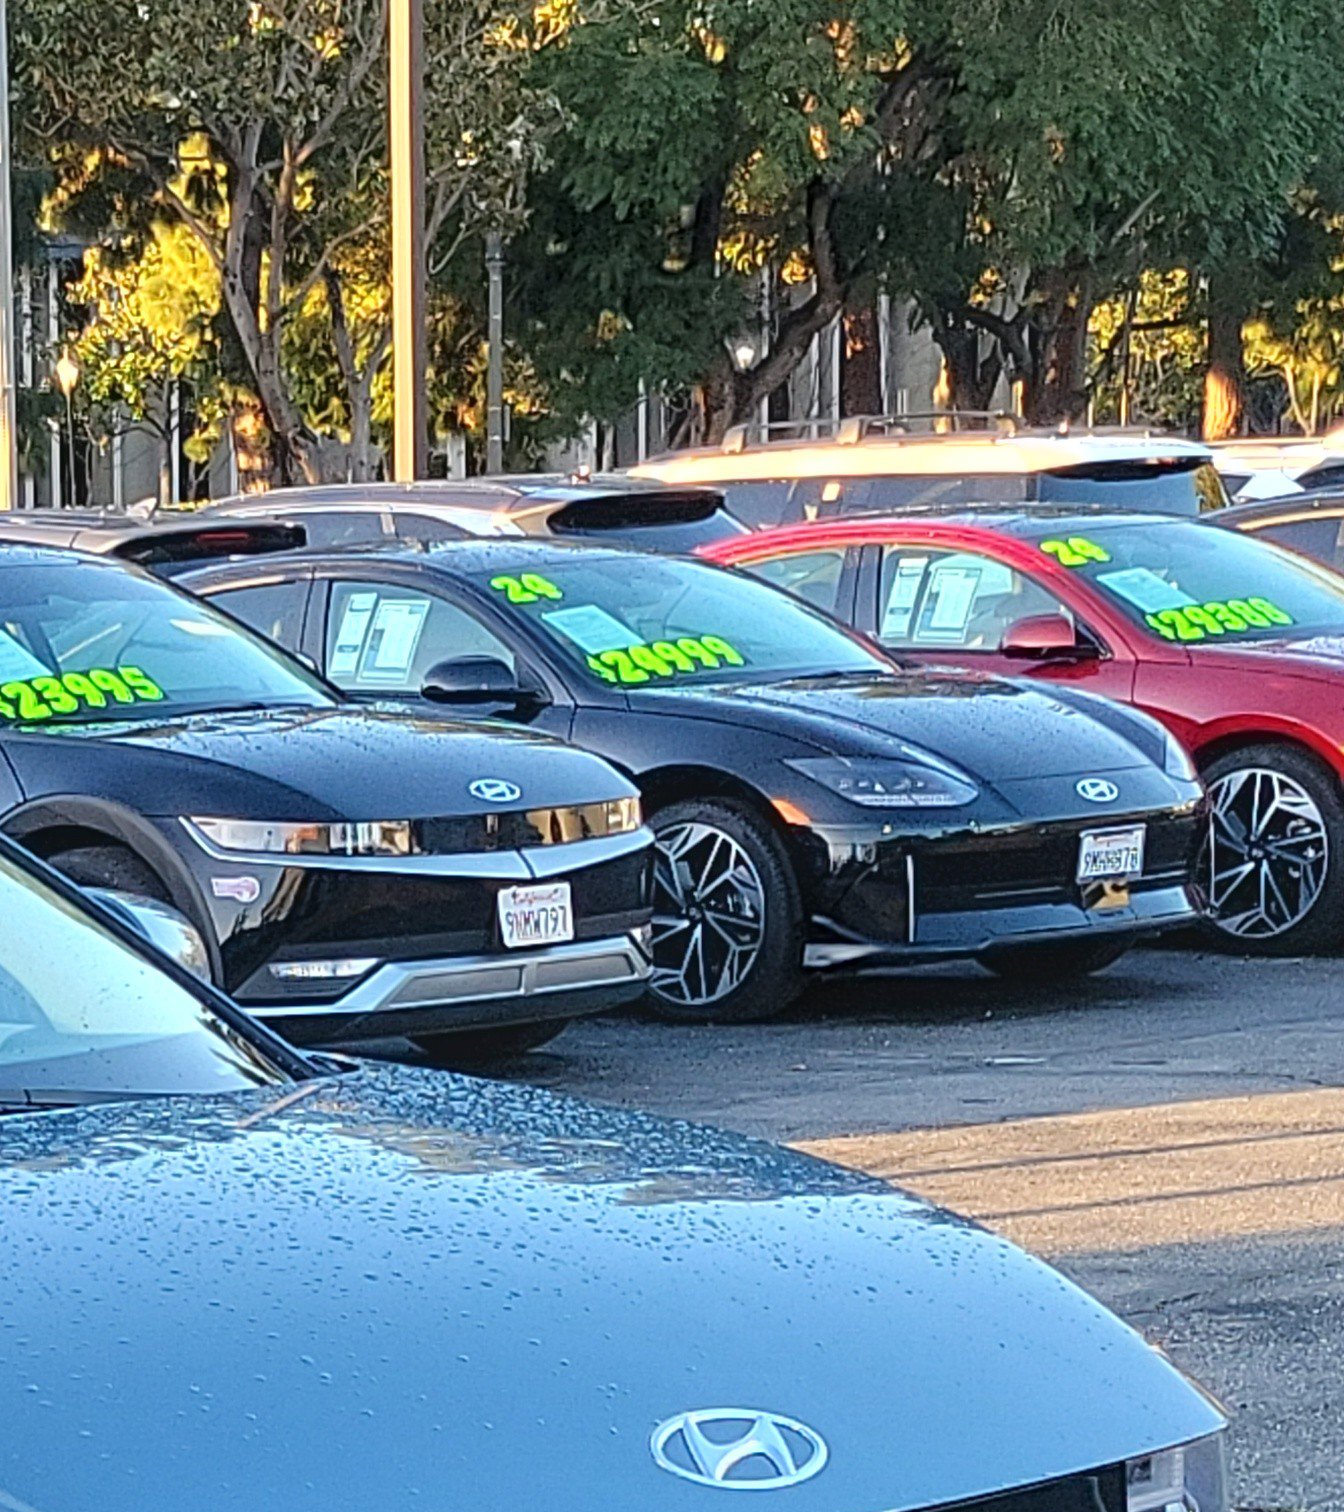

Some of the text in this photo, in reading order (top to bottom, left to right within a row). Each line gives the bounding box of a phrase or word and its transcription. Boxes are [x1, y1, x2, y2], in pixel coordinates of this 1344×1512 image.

[1040, 537, 1111, 567] 24
[490, 573, 563, 604] 24
[586, 635, 745, 684] $24999
